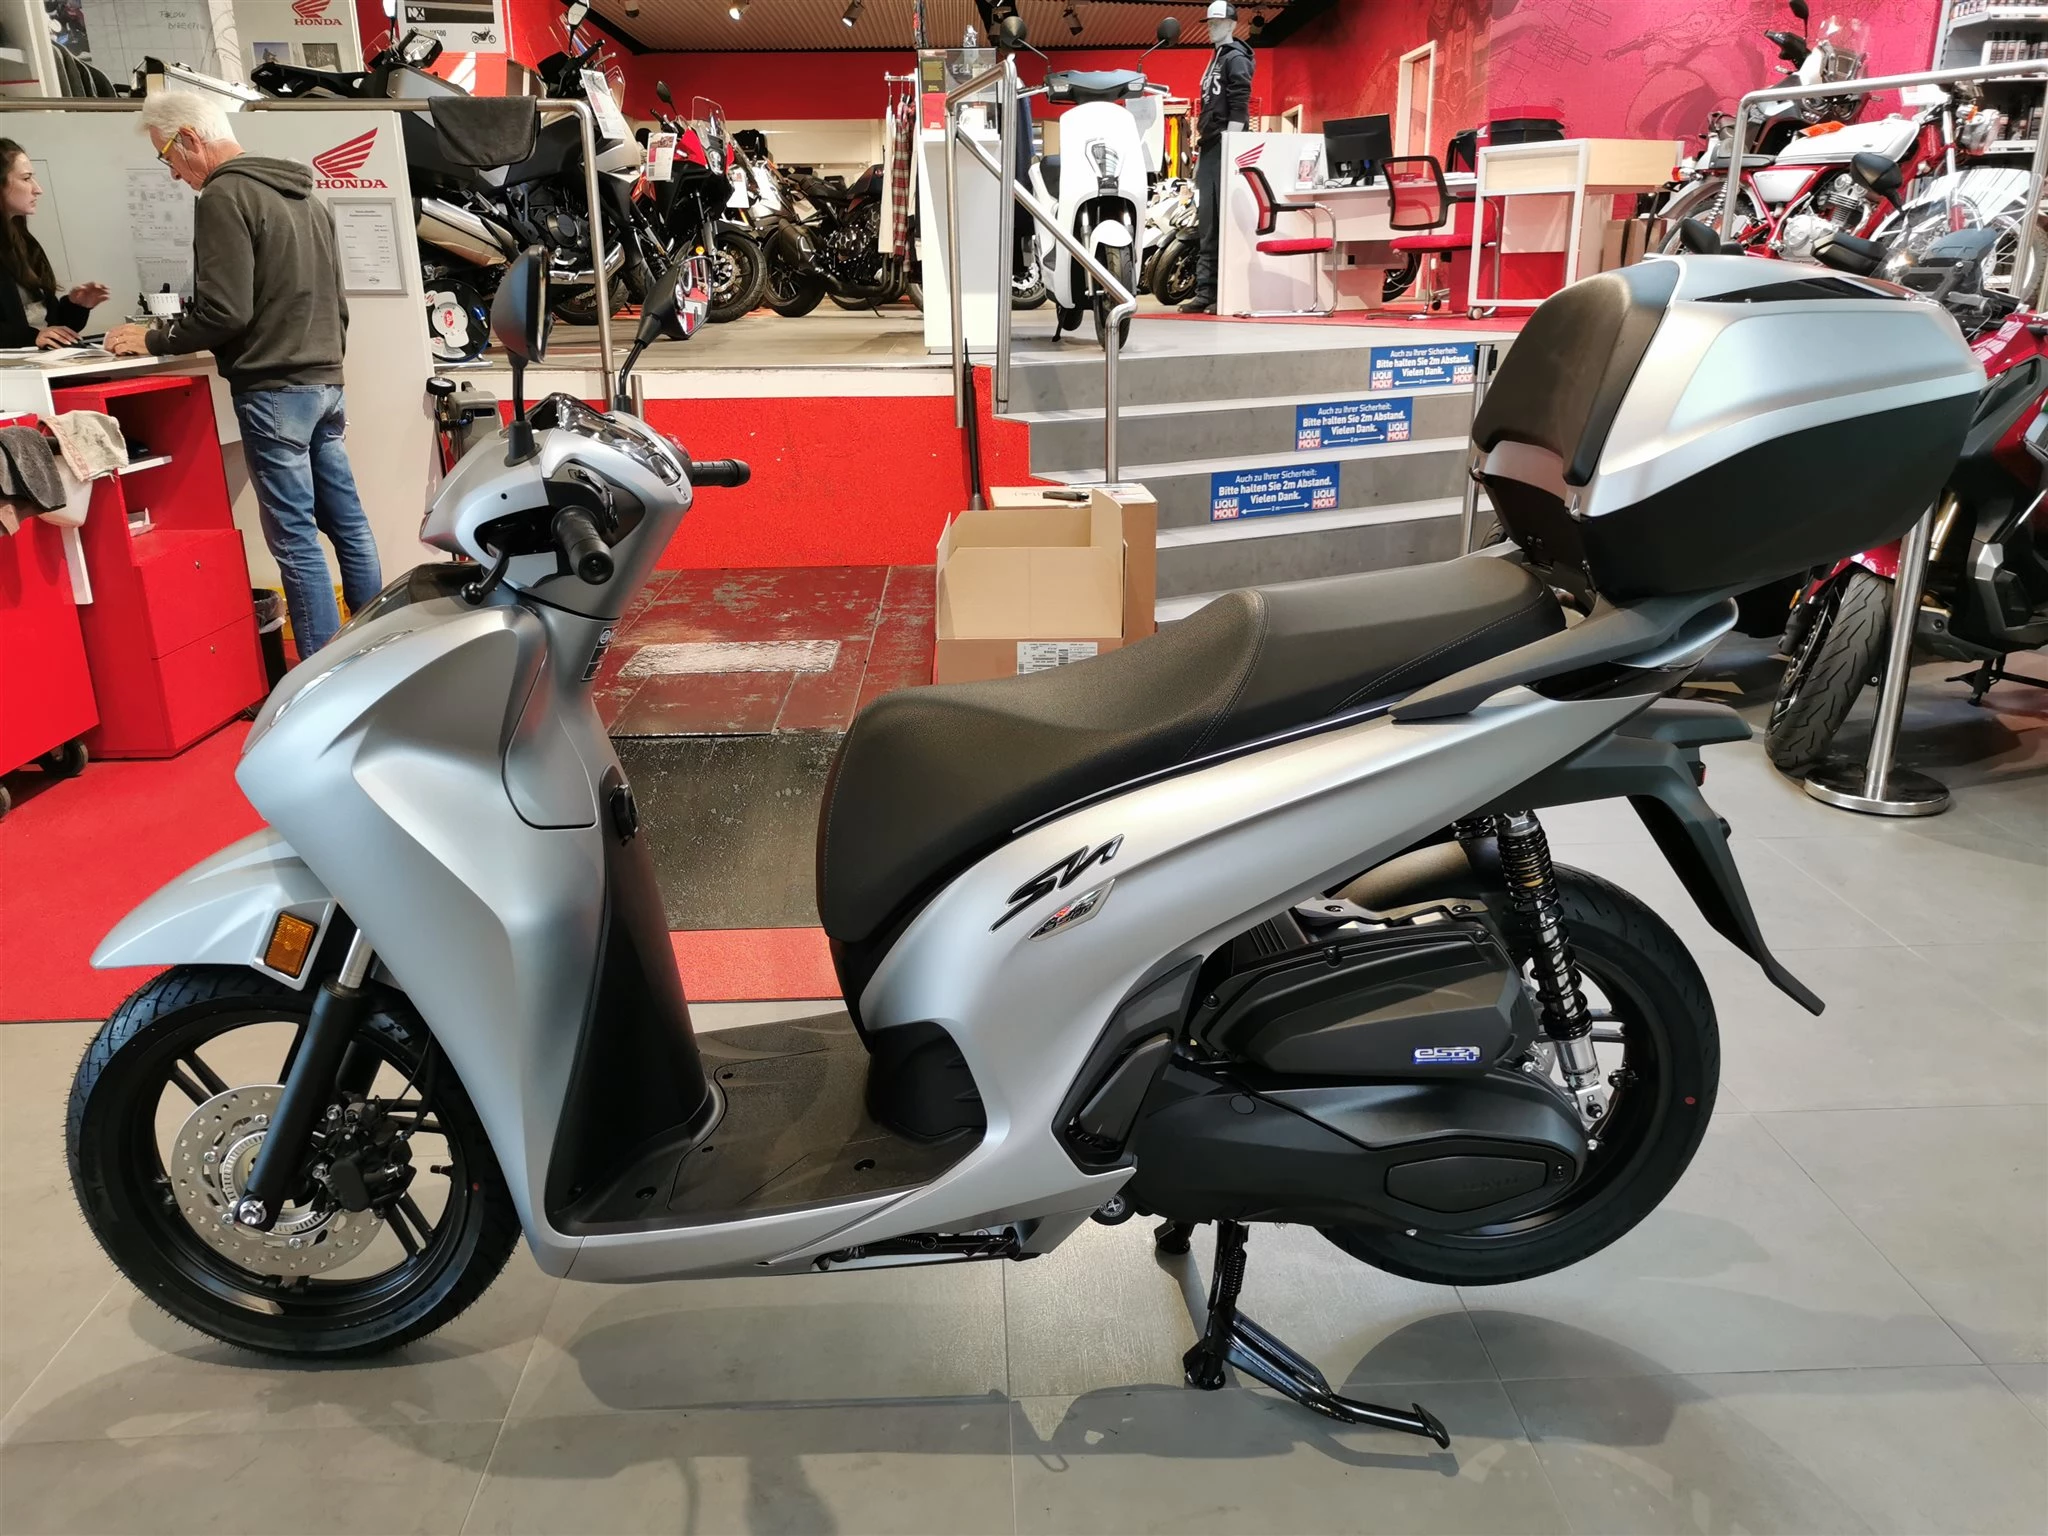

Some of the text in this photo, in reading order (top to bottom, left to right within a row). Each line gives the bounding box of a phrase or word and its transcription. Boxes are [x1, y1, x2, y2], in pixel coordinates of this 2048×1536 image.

[407, 8, 426, 18] NX
[294, 18, 342, 26] HONDA
[315, 180, 388, 188] HONDA
[1428, 347, 1458, 355] Sicherheit:
[1376, 360, 1393, 368] Bitte
[1394, 358, 1416, 367] halten
[1417, 357, 1428, 365] Sie
[1441, 355, 1470, 364] Abstand.
[1402, 367, 1444, 376] Vielen Dank.
[1454, 365, 1474, 373] LIQUI
[1372, 371, 1392, 379] LIQUI
[1359, 403, 1392, 412] Sicherheit:
[1303, 411, 1405, 427] Bitte halten Sie 2m Abstand.
[1331, 424, 1377, 435] Vielen Dank.
[1389, 423, 1408, 431] LIQUI
[1299, 431, 1320, 439] LIQUI
[1388, 431, 1409, 441] MOLY
[1298, 440, 1320, 448] MOLY
[1281, 469, 1317, 479] Sicherheit:
[1219, 476, 1332, 496] Bitte halten Sie 2m Abstand.
[1251, 491, 1301, 504] Vielen Dank.
[1313, 489, 1335, 498] LIQUI
[1215, 499, 1237, 509] LIQUI
[1312, 498, 1335, 508] MOLY
[1214, 509, 1238, 519] MOLY
